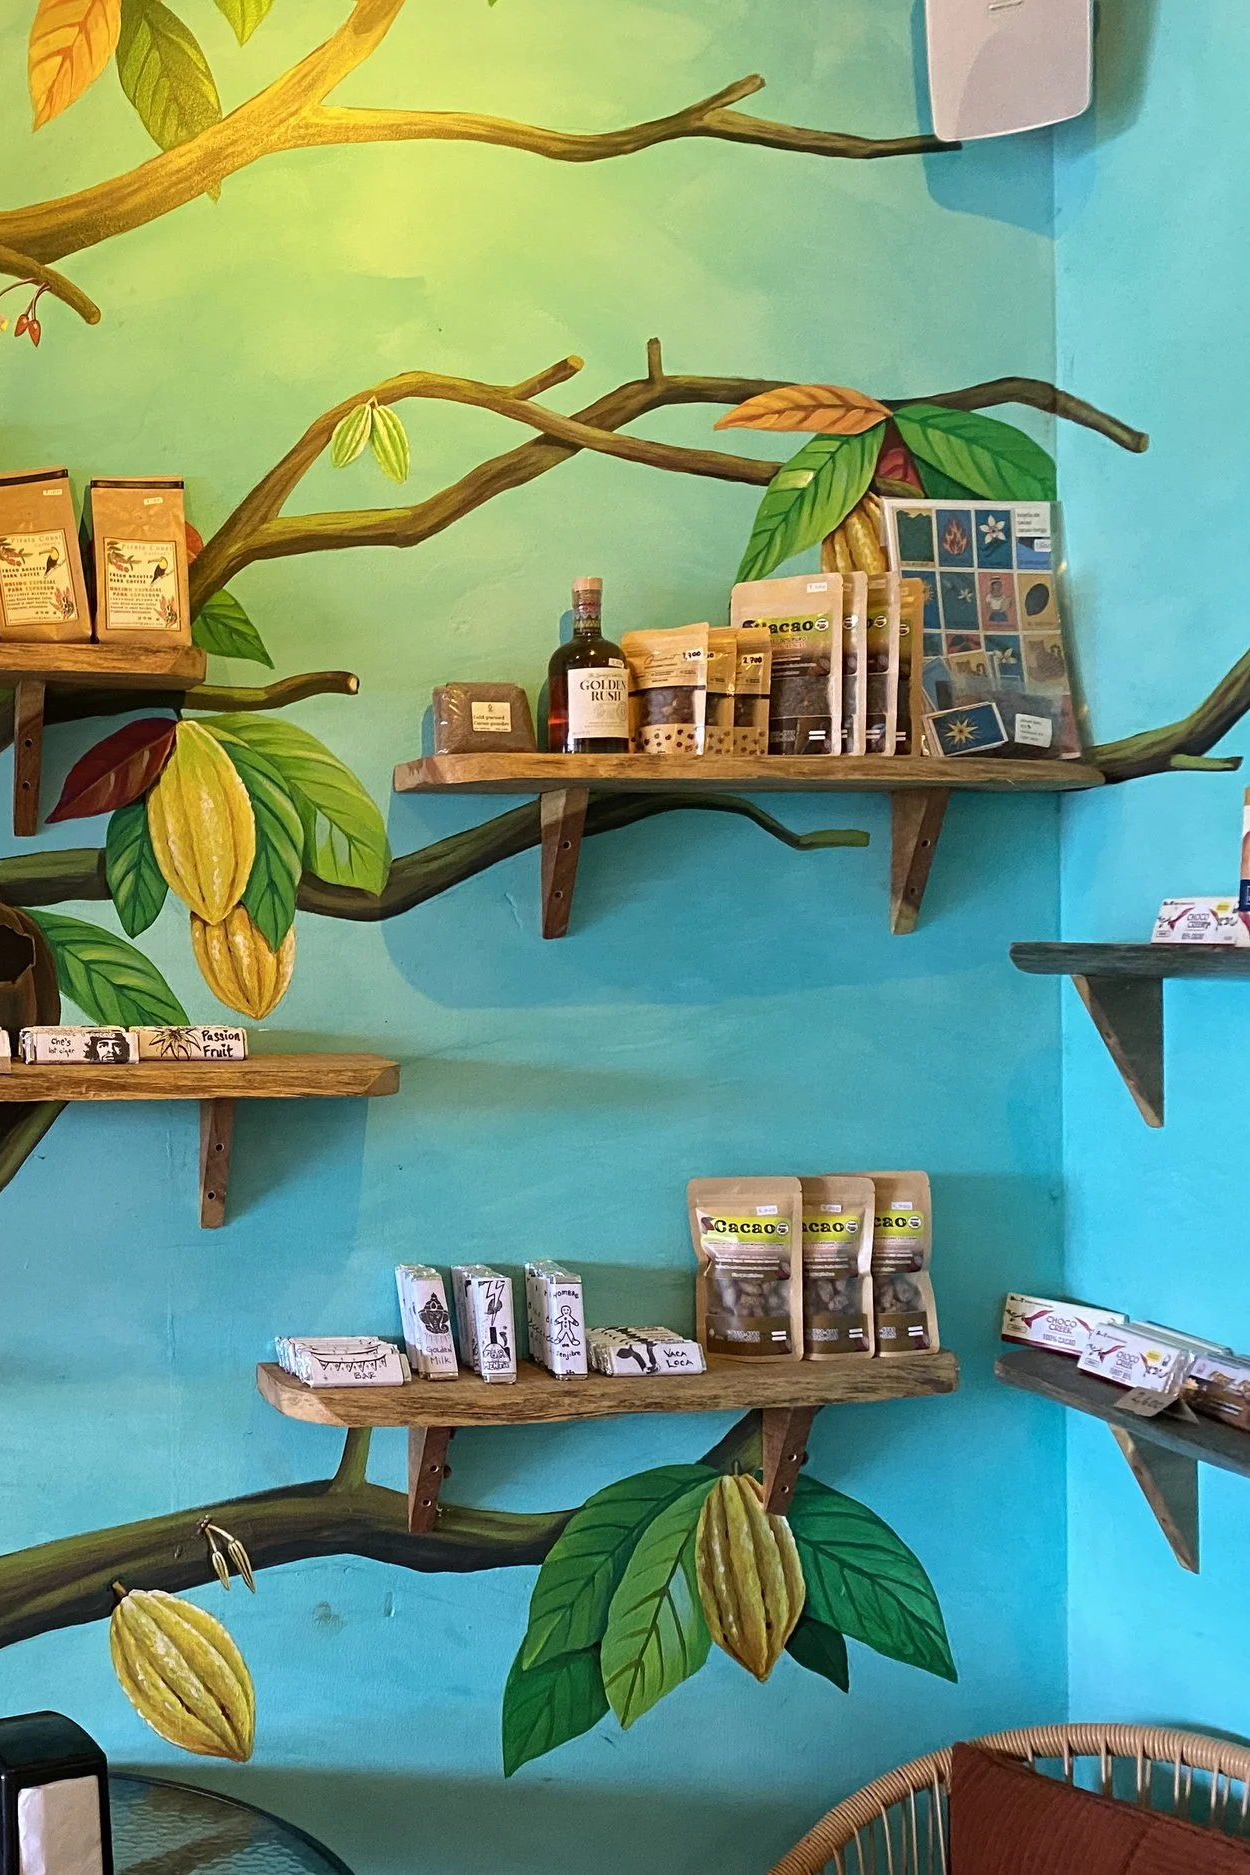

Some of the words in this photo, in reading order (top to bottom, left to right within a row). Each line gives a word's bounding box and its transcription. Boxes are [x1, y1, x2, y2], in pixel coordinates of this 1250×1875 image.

[761, 620, 813, 634] acao
[580, 680, 626, 690] GOLDEN
[592, 691, 621, 701] RUSH
[51, 1037, 71, 1046] Che's
[200, 1030, 241, 1042] Passion
[202, 1044, 234, 1058] Fruit
[714, 1220, 776, 1234] Cacao
[802, 1222, 844, 1233] cao
[874, 1217, 906, 1228] cao
[1046, 1316, 1077, 1328] CHOCO
[1049, 1324, 1072, 1334] CREEK
[663, 1348, 687, 1357] VACA
[1117, 1351, 1139, 1363] CHOCO
[430, 1356, 452, 1365] Milk
[666, 1360, 693, 1368] LOCA
